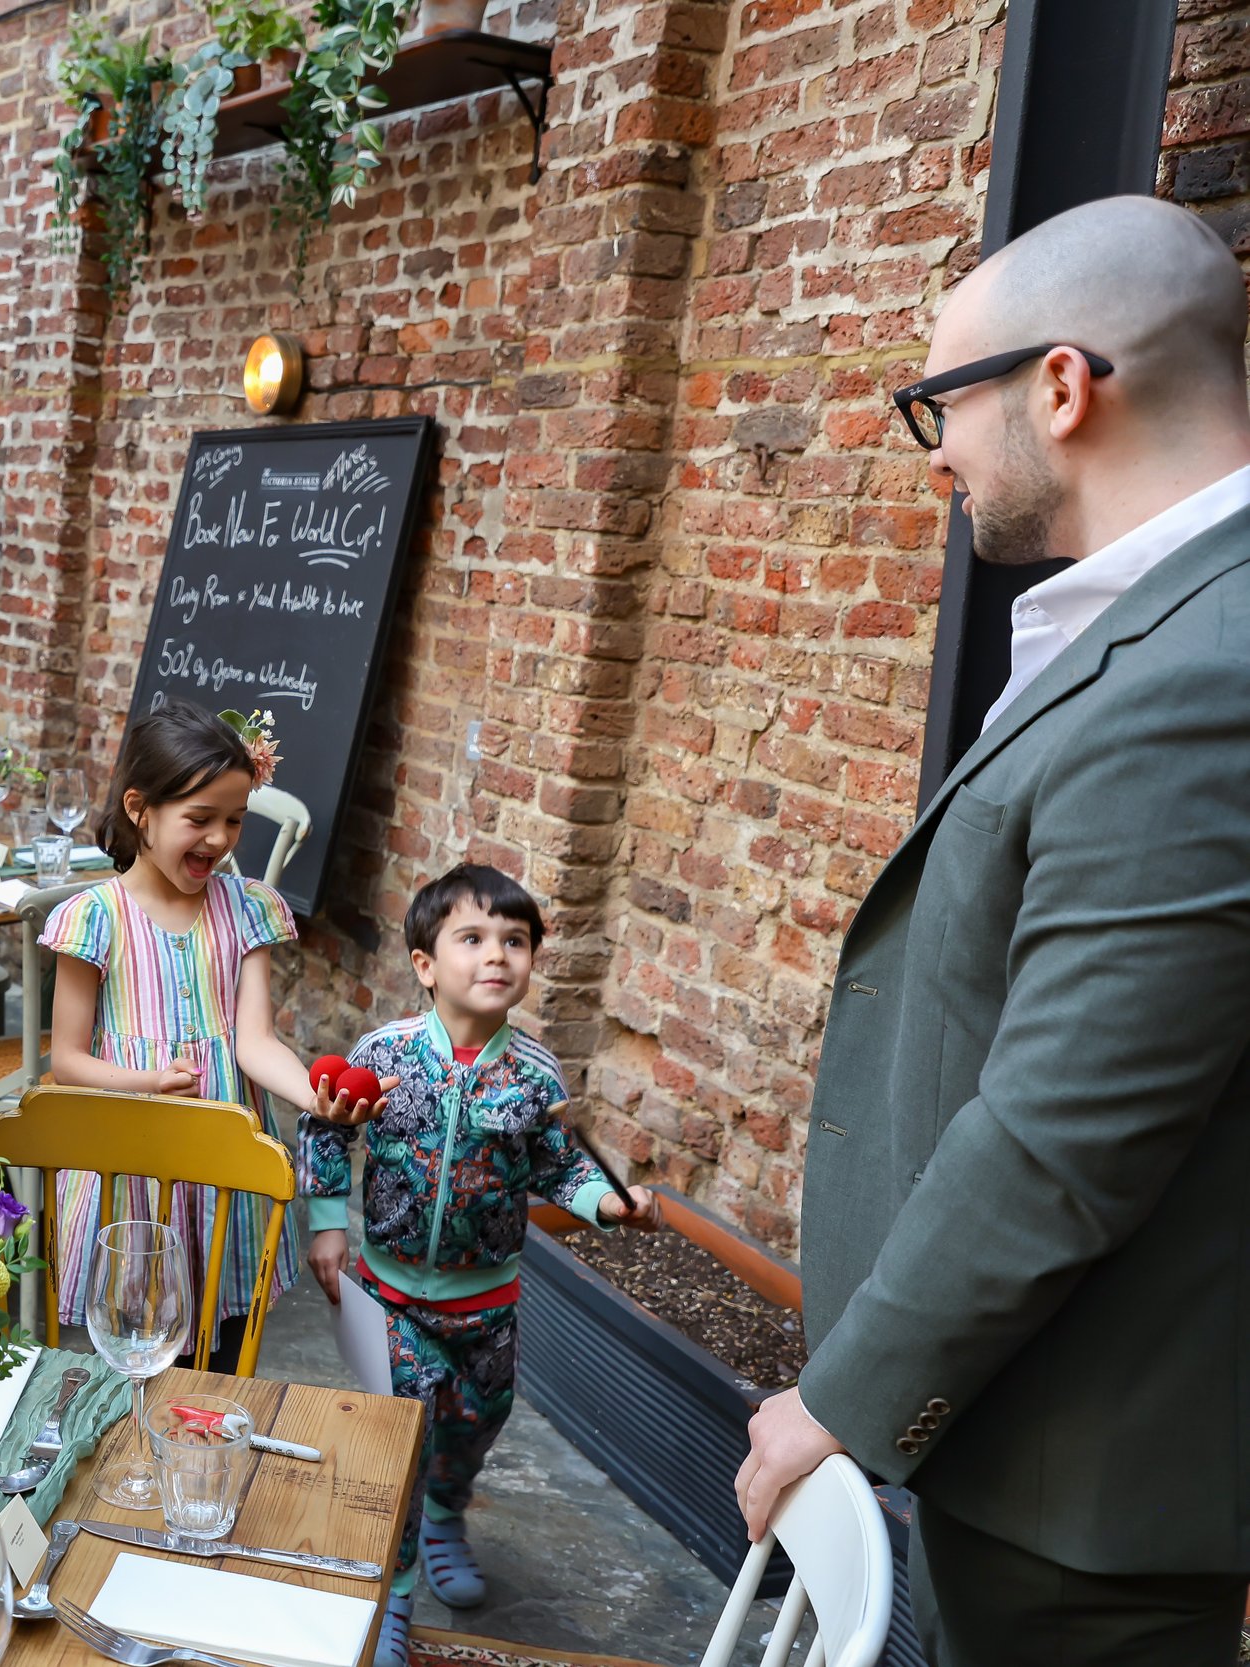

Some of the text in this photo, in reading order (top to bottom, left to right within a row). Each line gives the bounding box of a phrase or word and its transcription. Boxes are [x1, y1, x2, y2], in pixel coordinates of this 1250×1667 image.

[290, 500, 338, 546] World
[340, 503, 386, 557] Cup!
[157, 638, 196, 678] 50%
